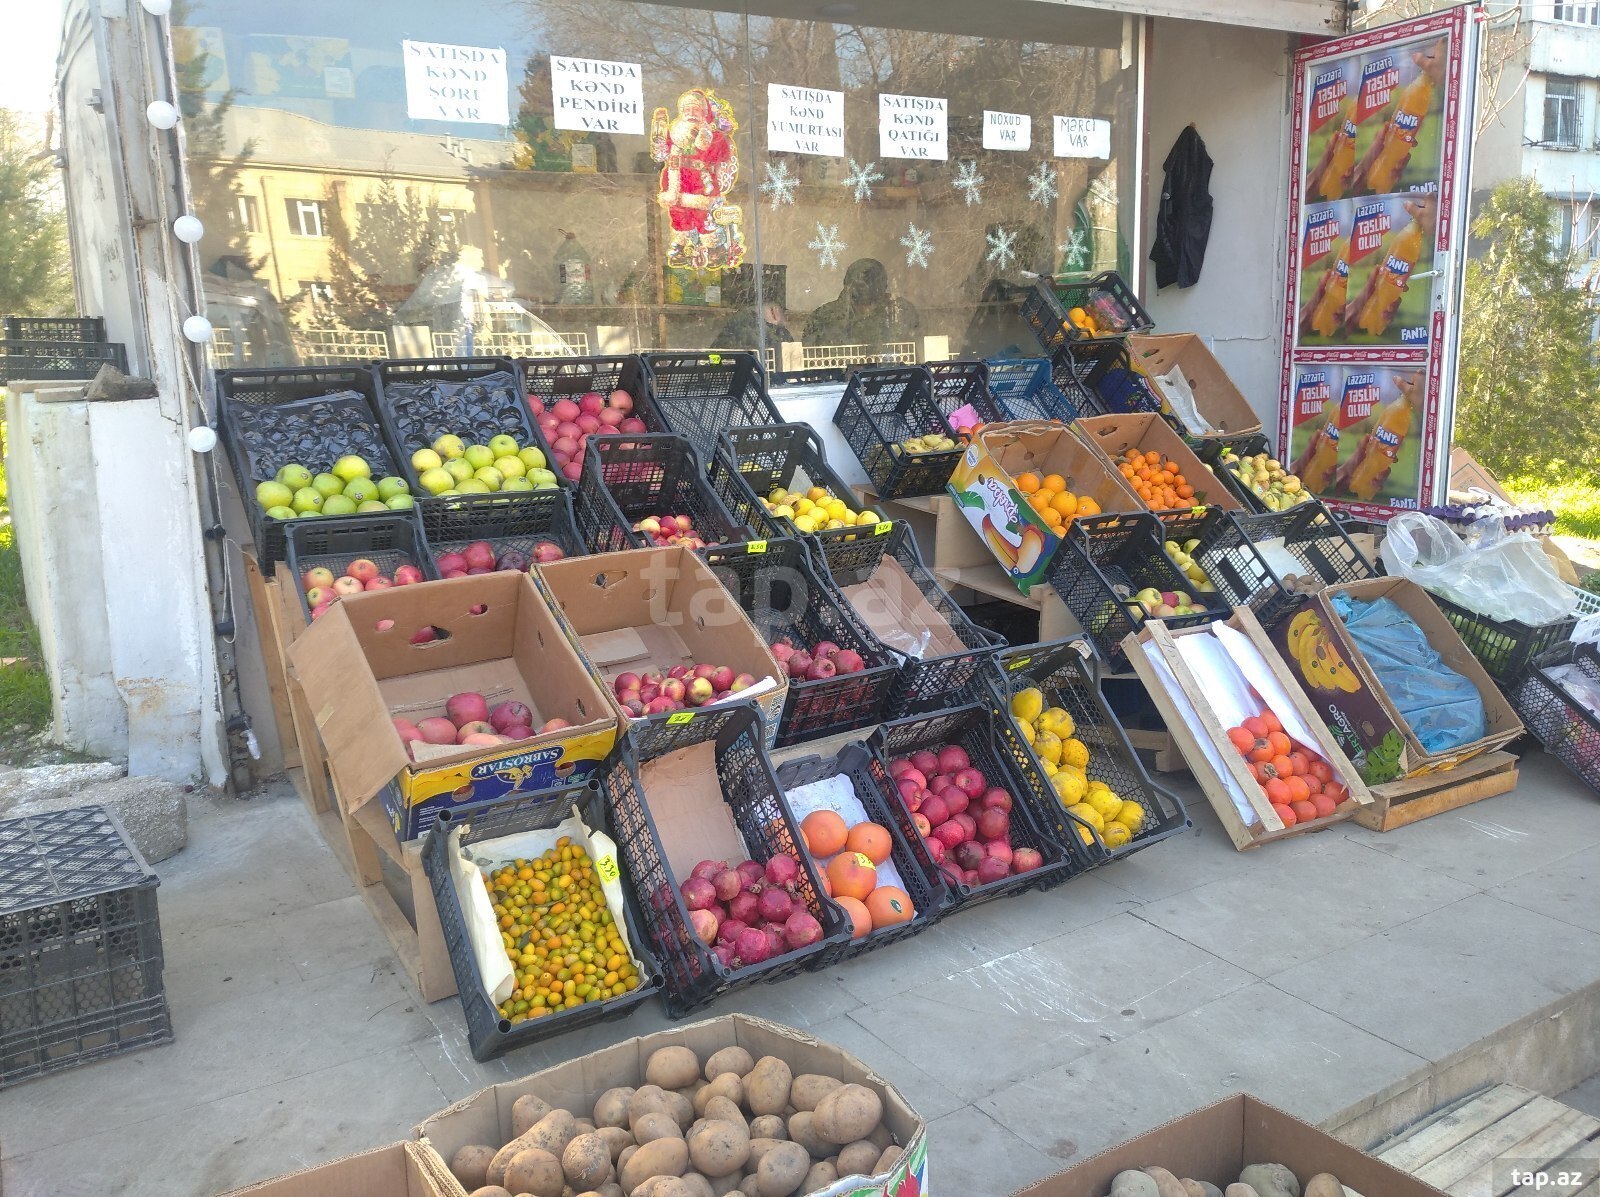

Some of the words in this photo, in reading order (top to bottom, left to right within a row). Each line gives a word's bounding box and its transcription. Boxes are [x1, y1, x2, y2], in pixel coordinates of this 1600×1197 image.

[556, 59, 636, 78] SATIŞDA
[570, 80, 625, 94] KƏND
[782, 88, 832, 104] SATIŞDA
[1366, 88, 1390, 108] OLUN
[560, 96, 636, 114] PENDİRİ
[884, 96, 944, 112] SATIŞDA
[1318, 100, 1339, 118] OLUN
[790, 106, 824, 120] KƏND
[894, 114, 934, 126] KƏND
[990, 113, 1021, 126] NOXUD
[582, 116, 620, 130] VAR
[772, 120, 842, 138] YUMURTASI
[888, 130, 939, 142] QATIĞI
[1000, 130, 1016, 142] VAR
[1070, 134, 1089, 148] VAR
[796, 140, 819, 152] VAR
[900, 146, 928, 156] VAR
[1410, 182, 1438, 192] FANTA
[1310, 238, 1331, 256] OLUN
[1358, 233, 1382, 250] OLUN
[1401, 326, 1428, 340] FANTA
[1302, 400, 1322, 414] OLUN
[1348, 403, 1372, 418] OLUN
[1390, 498, 1418, 508] FANTA
[478, 748, 560, 774] SABROSTAR
